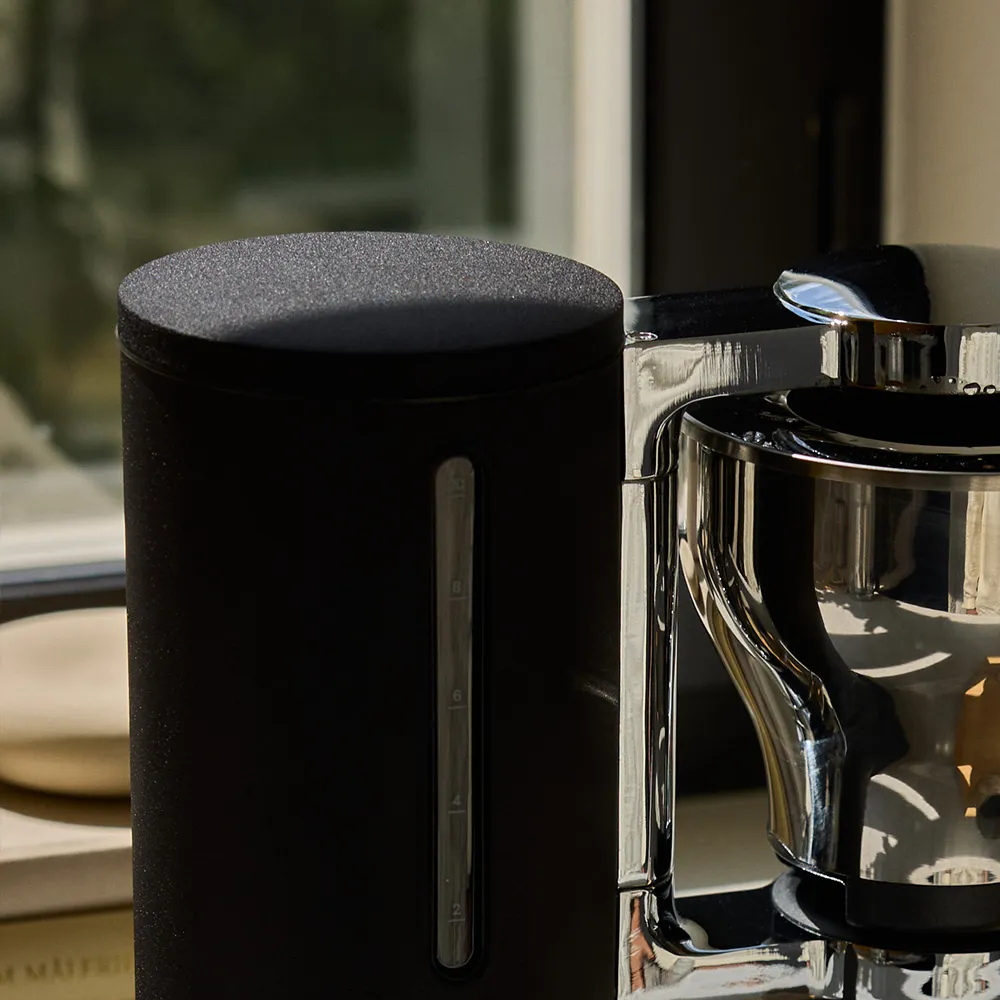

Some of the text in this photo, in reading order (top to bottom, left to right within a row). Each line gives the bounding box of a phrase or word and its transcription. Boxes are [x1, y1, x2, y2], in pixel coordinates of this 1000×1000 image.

[452, 689, 462, 702] 6
[452, 794, 462, 806] 4
[452, 903, 462, 916] 2
